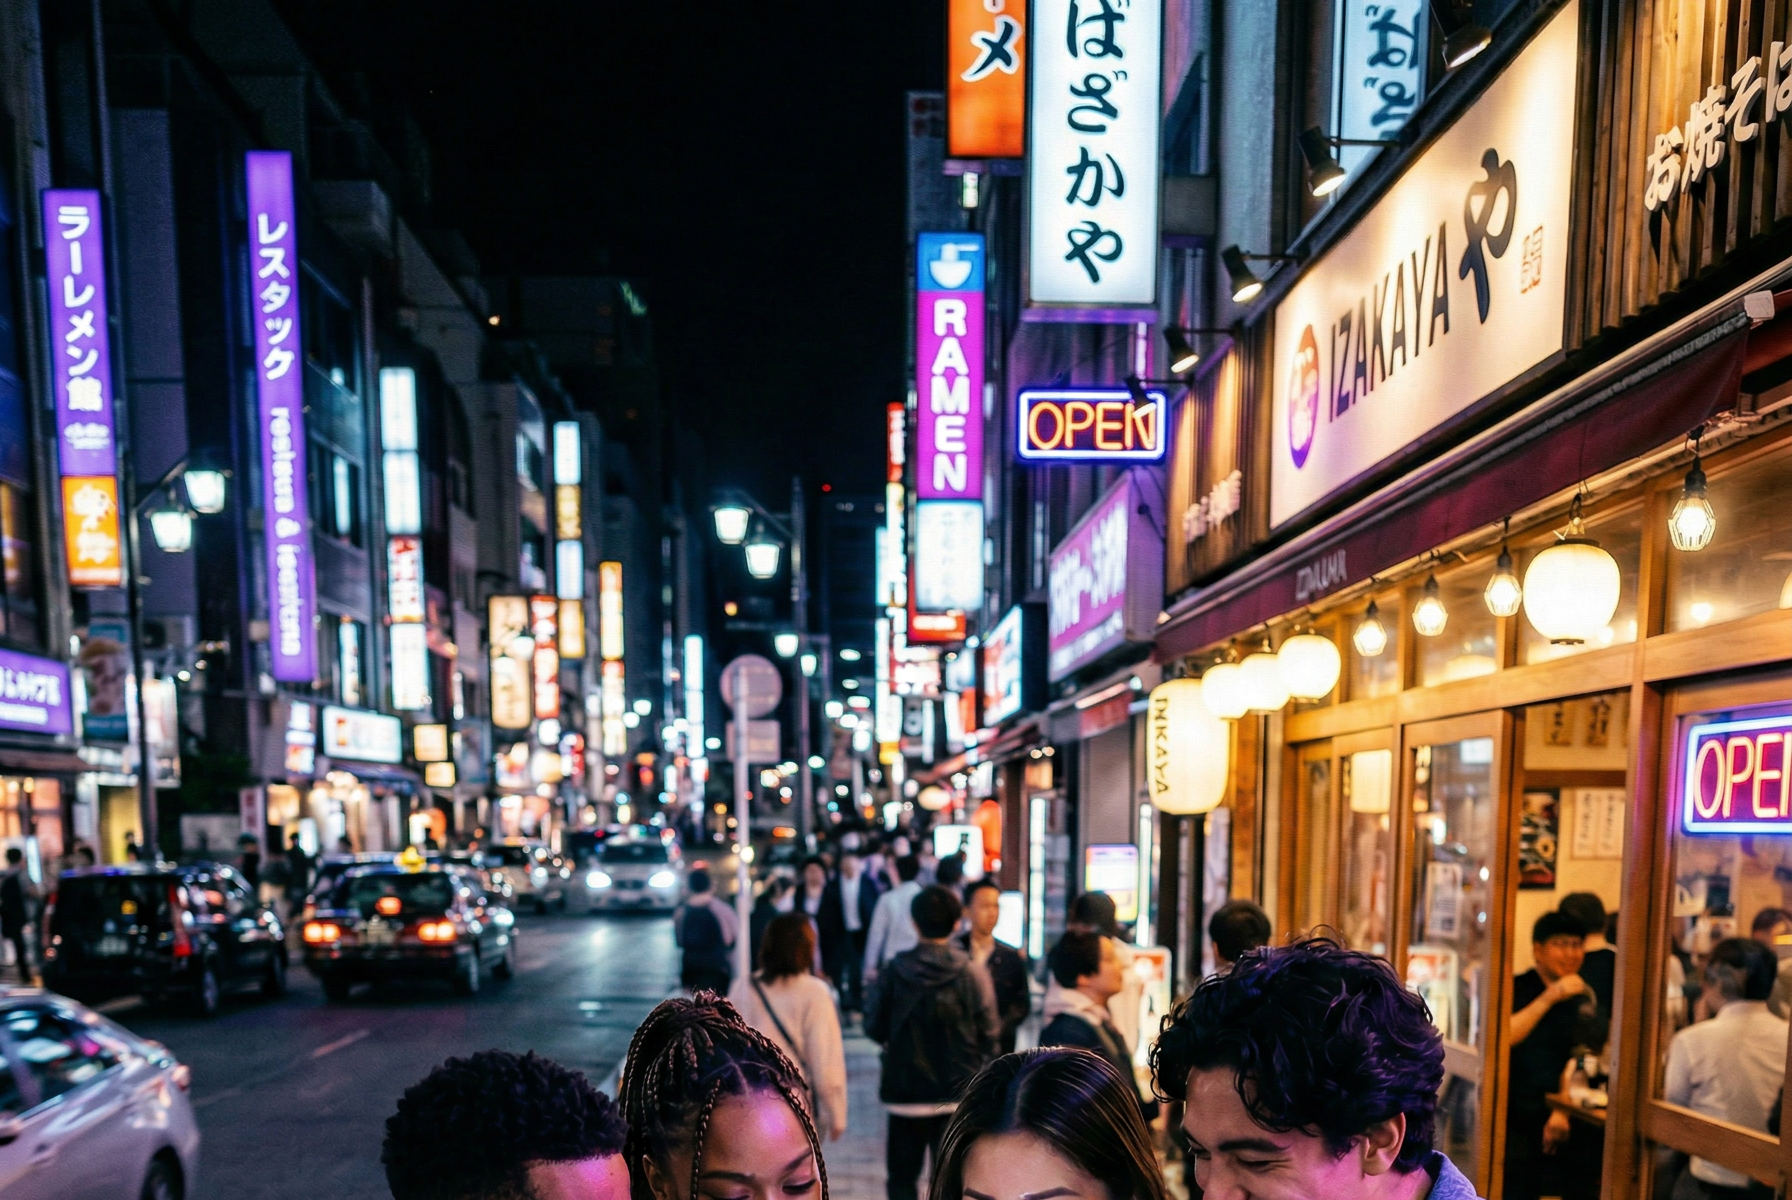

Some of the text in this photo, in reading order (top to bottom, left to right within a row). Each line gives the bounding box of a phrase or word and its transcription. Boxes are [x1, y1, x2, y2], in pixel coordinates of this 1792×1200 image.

[1329, 220, 1450, 423] IZAKAYA
[1459, 147, 1518, 325] や
[930, 299, 970, 493] RAMEN
[1028, 401, 1157, 451] OPEN
